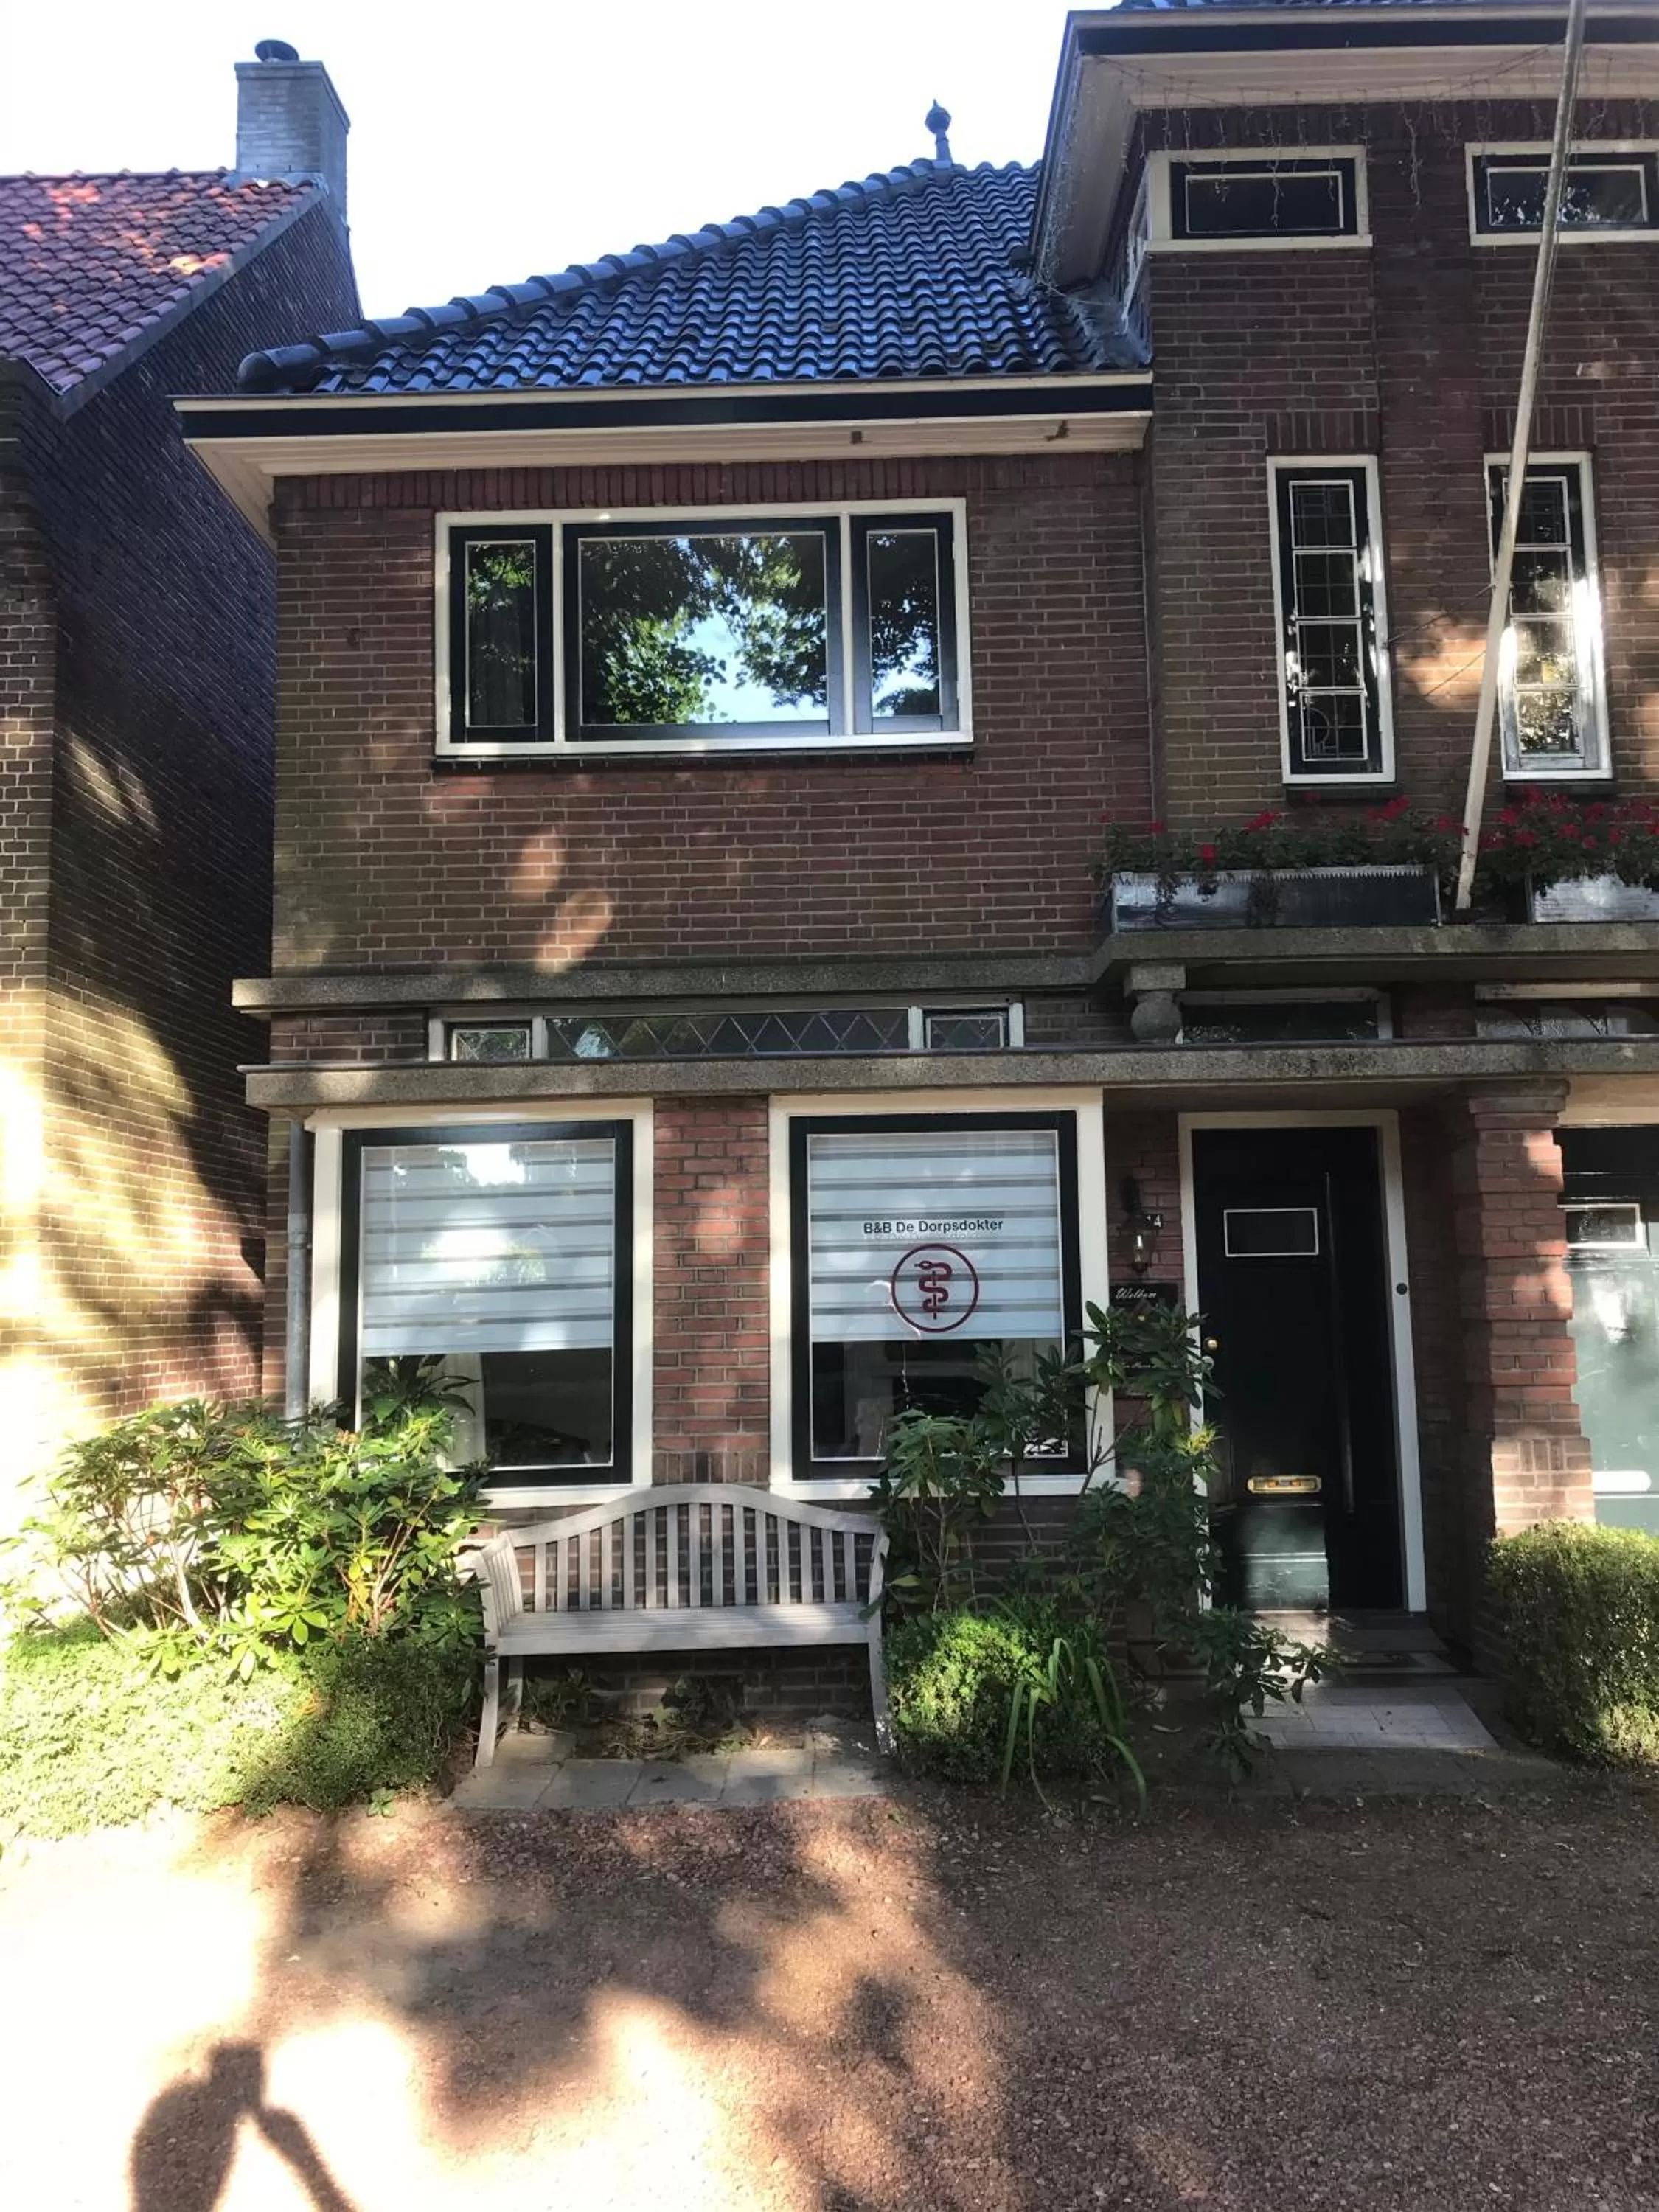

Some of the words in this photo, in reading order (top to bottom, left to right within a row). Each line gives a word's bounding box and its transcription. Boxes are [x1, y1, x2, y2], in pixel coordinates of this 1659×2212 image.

[863, 1222, 892, 1234] B&B
[896, 1221, 914, 1232] De
[918, 1219, 1004, 1234] Dorpsdokter
